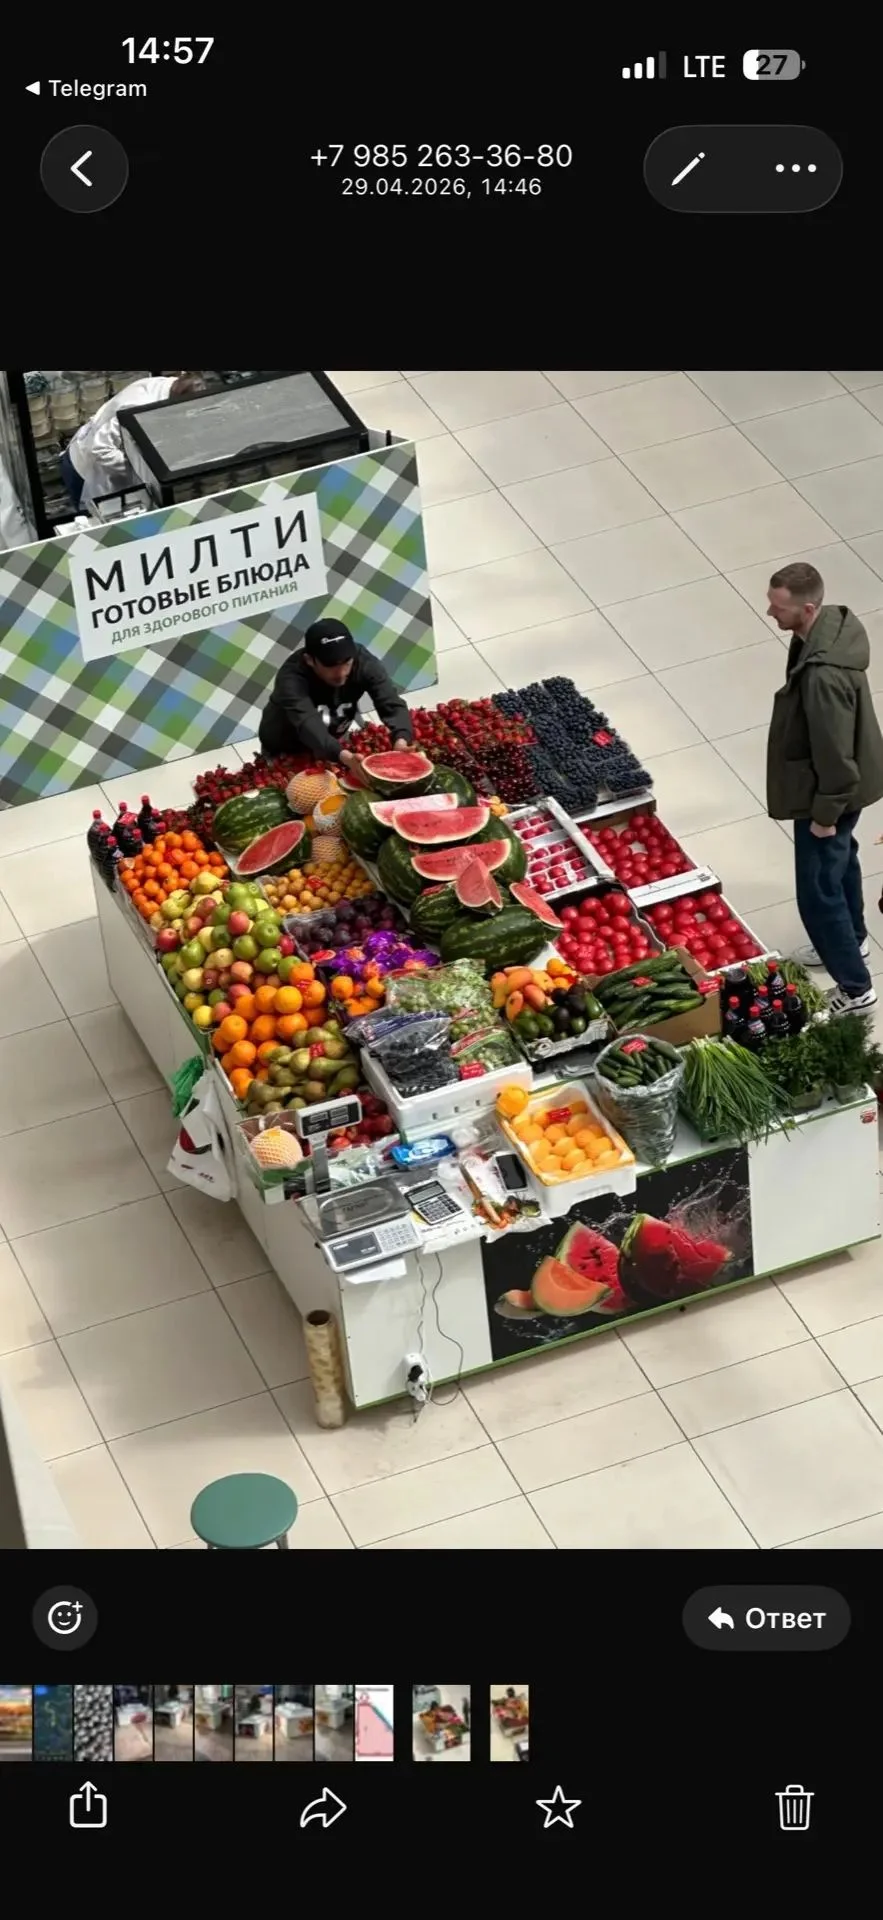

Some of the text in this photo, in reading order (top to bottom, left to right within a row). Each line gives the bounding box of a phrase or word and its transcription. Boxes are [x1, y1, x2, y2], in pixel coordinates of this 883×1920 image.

[85, 510, 308, 601] МИЛТИ
[91, 553, 310, 629] ГОТОВЫЕ БЛЮДА
[111, 580, 299, 645] ДЛЯ ЗДОРОВОГО ПИТАНИЯ
